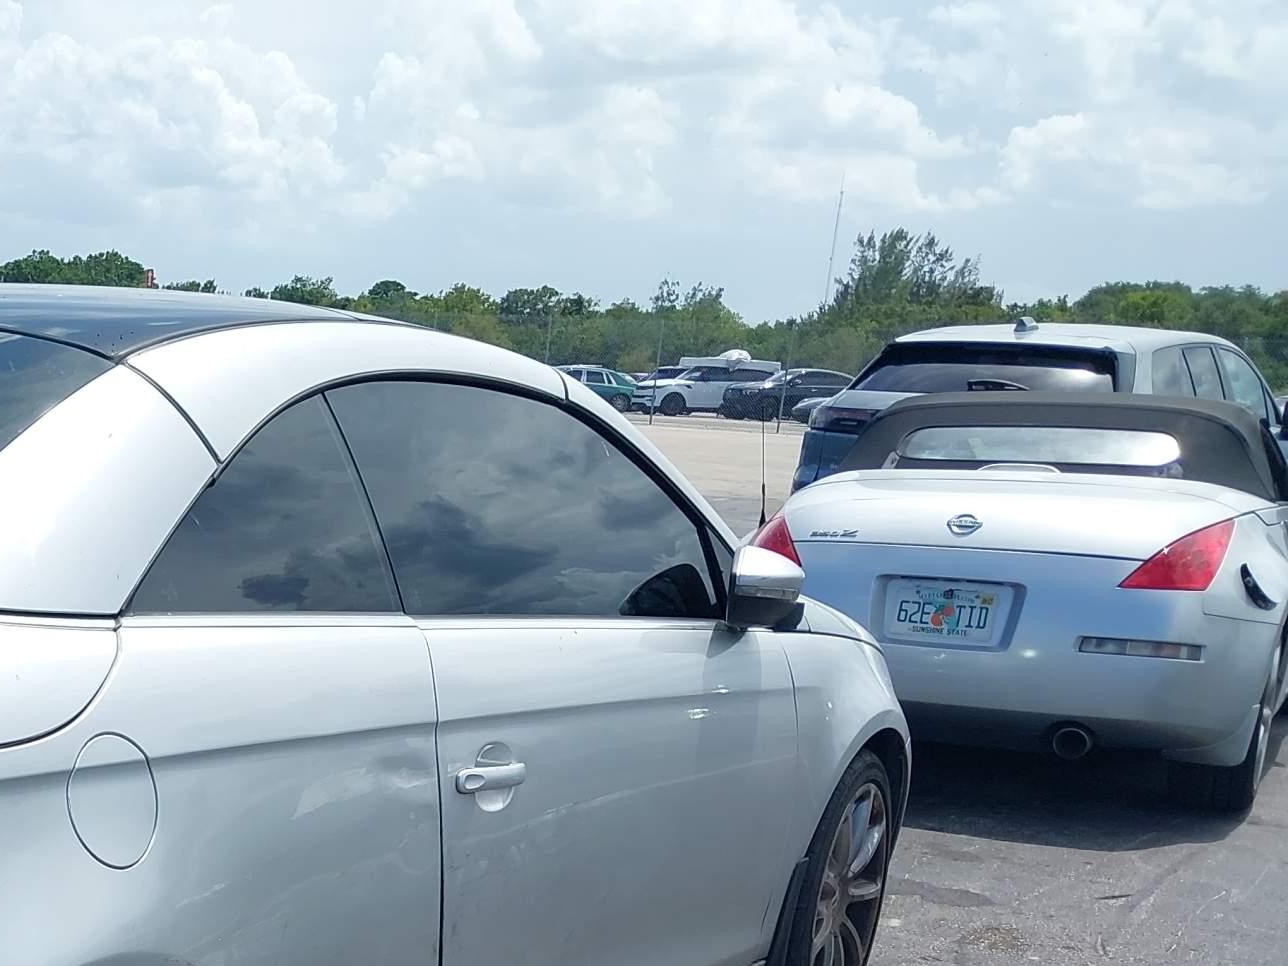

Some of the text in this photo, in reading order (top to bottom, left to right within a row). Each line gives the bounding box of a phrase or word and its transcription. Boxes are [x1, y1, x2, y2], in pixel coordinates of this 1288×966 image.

[897, 600, 989, 630] 62E TID
[911, 625, 968, 638] SUNSHINE STATE
